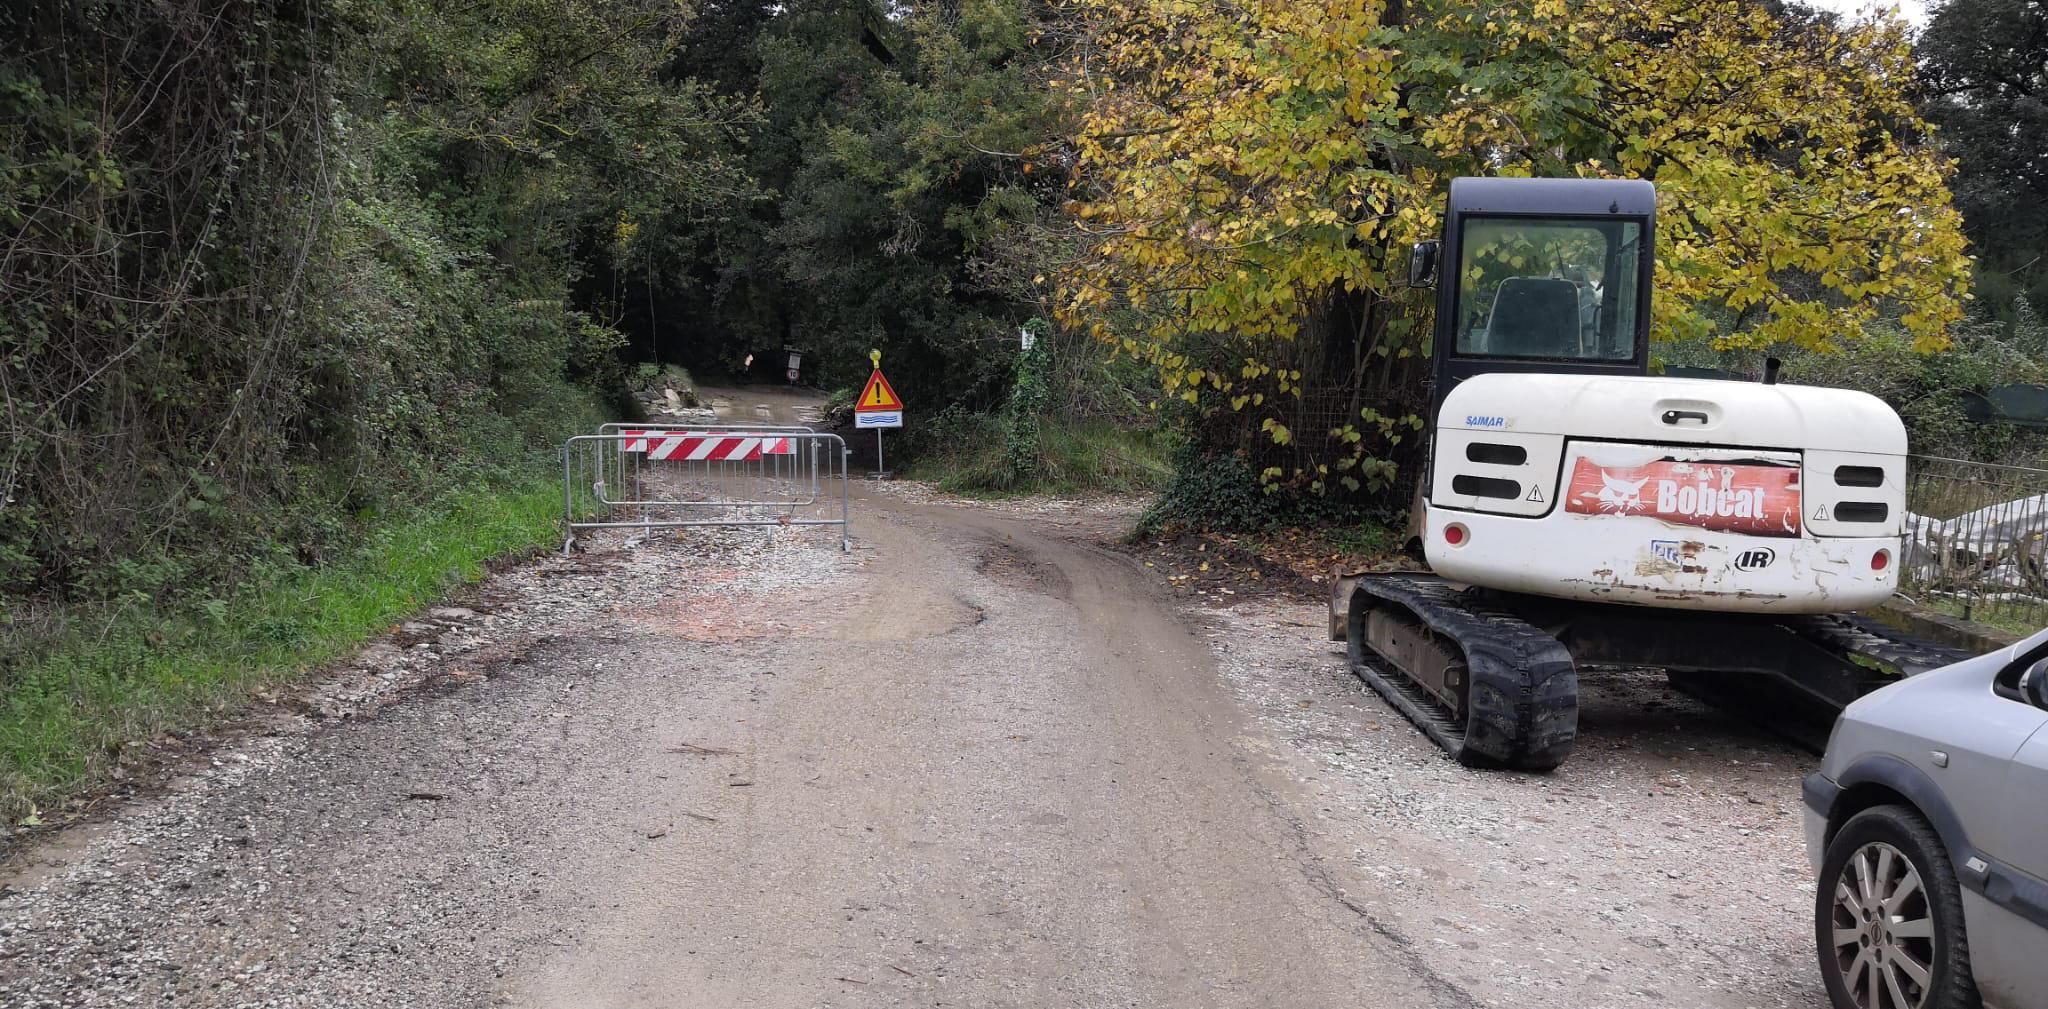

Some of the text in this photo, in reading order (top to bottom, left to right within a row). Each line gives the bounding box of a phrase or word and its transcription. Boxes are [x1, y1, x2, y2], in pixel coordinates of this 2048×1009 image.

[1465, 415, 1505, 427] SAIMAR
[1657, 479, 1765, 518] Bobcat
[1740, 550, 1770, 569] IR
